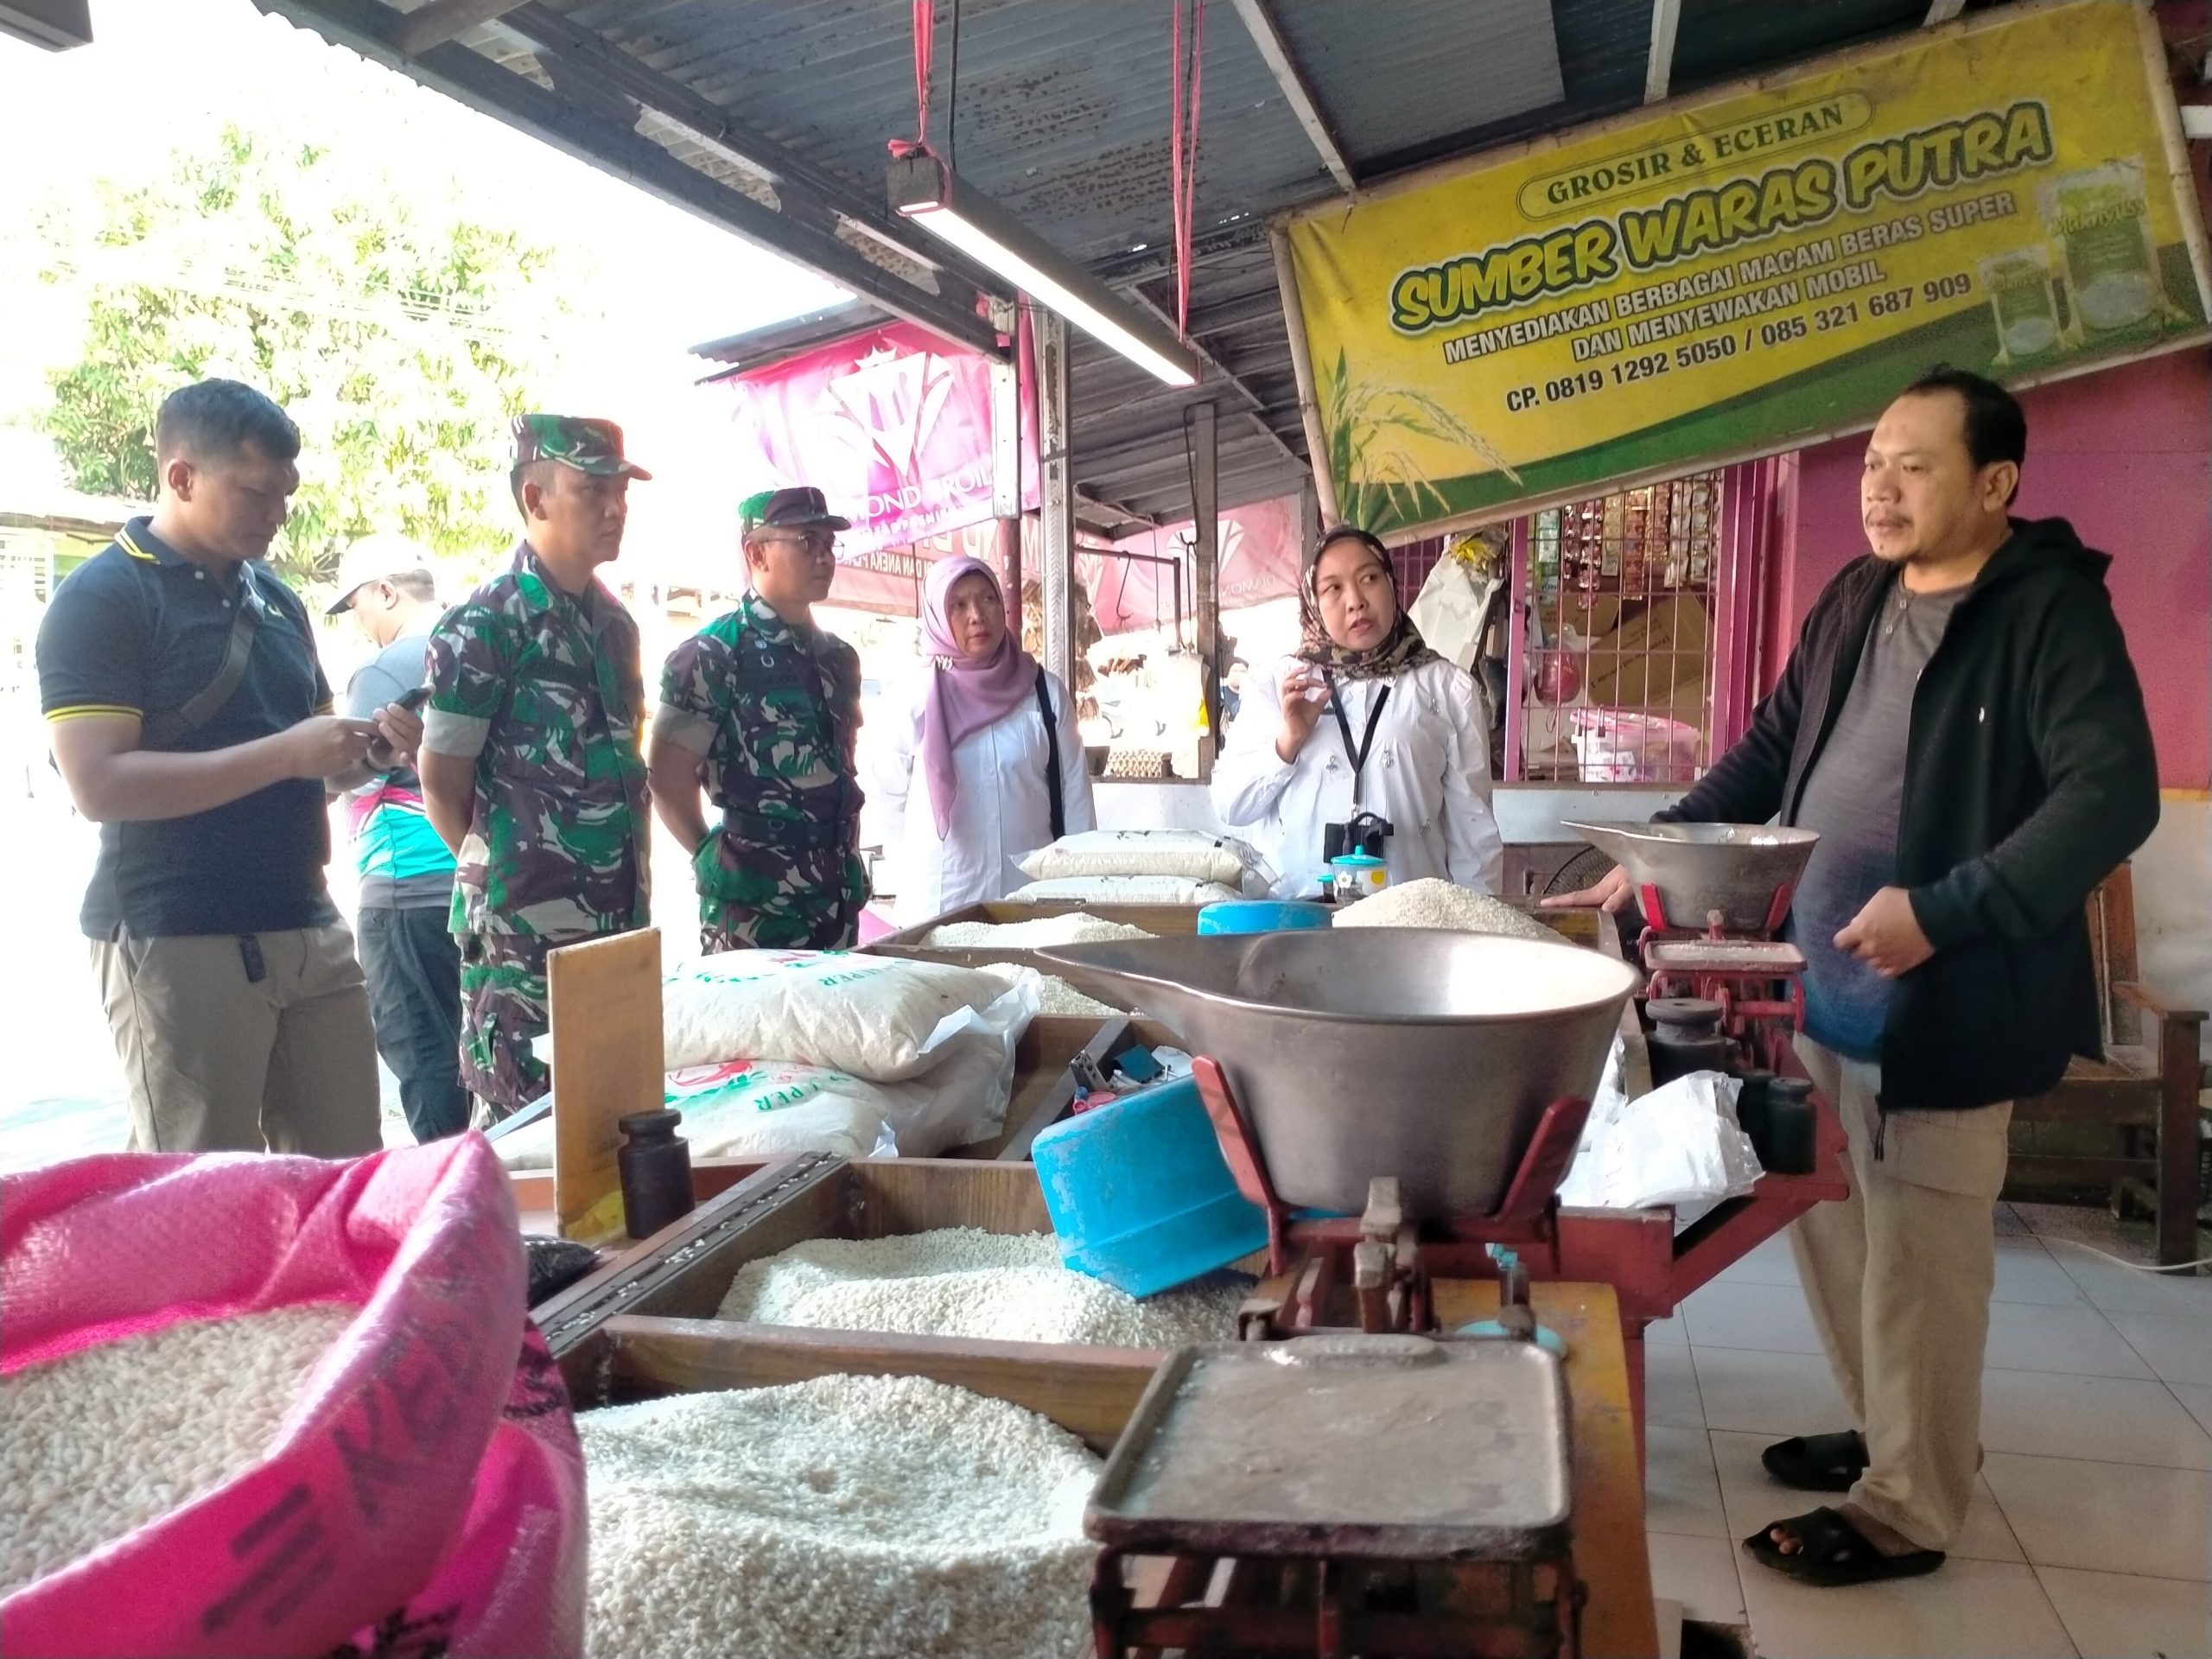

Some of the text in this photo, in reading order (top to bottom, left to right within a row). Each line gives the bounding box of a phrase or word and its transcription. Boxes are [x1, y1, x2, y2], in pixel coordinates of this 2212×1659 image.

[1393, 102, 2052, 330] SUMBER WARAS PUTRA
[1548, 103, 1843, 204] GROSIR & ECERAN
[1443, 192, 2015, 365] MENYEDIAKAN BERBAGAI MACAM BERAS SUPER
[1506, 388, 1540, 412] CP.
[1546, 369, 1603, 402] 0819
[1611, 351, 1669, 385] 1292
[1675, 334, 1736, 368] 5050
[1745, 328, 1752, 351] /
[1761, 315, 1807, 346] 085
[1815, 302, 1859, 332] 321
[1868, 286, 1913, 317] 687
[1923, 272, 1971, 302] 909
[1573, 260, 1886, 362] DAN MENYEWAKAN MOBIL
